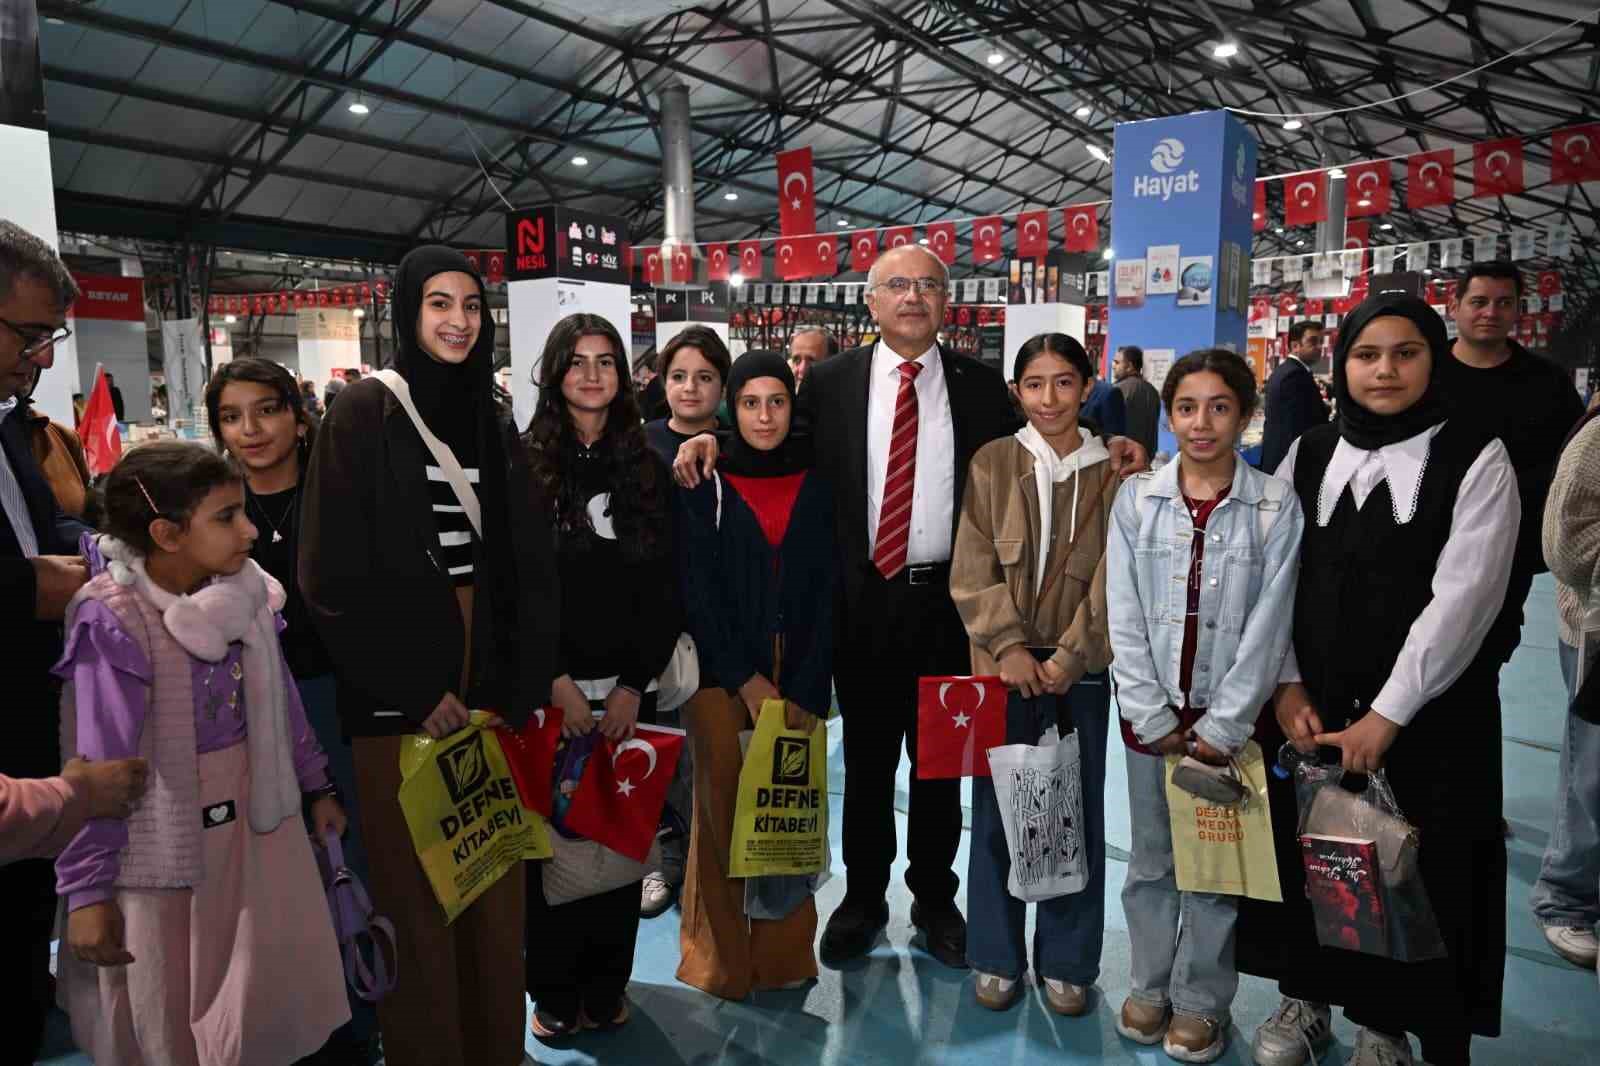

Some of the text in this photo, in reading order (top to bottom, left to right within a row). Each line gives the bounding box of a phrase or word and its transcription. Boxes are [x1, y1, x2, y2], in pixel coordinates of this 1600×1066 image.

[1134, 170, 1200, 201] Hayat
[440, 777, 516, 840] DEFNE
[756, 787, 820, 809] DEFNE
[753, 813, 818, 833] KİTABEVİ
[1197, 819, 1242, 831] MEDYA
[1198, 831, 1244, 842] GRUBU
